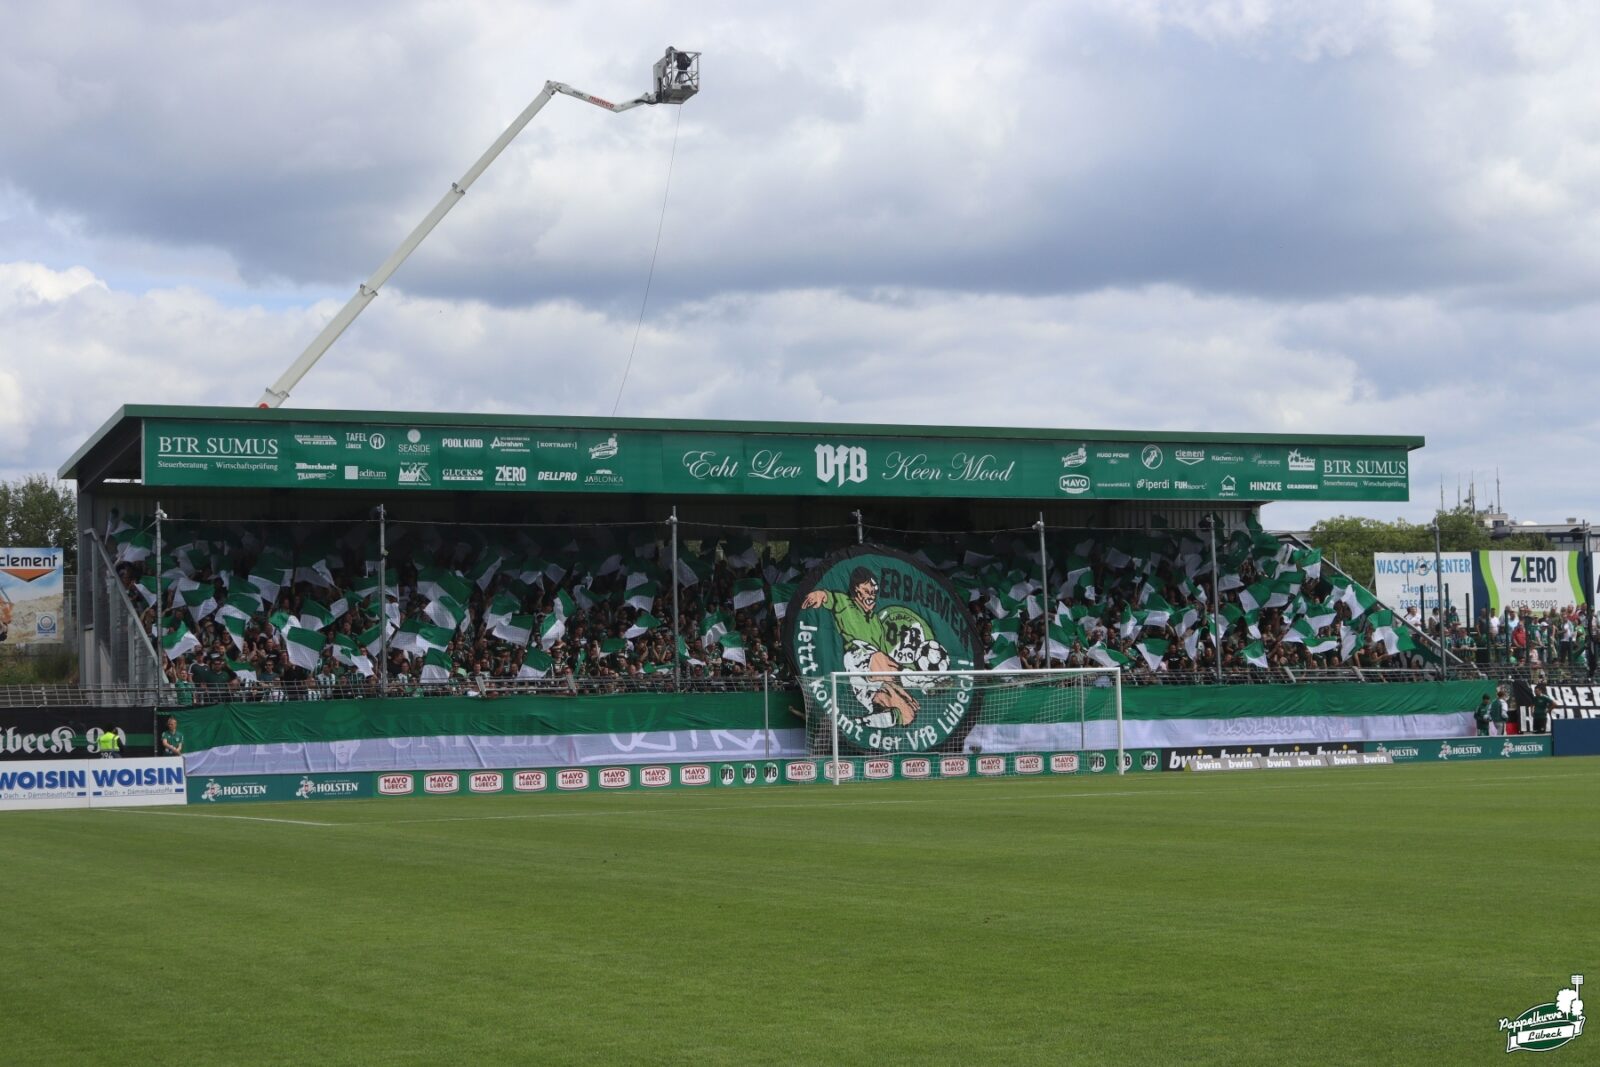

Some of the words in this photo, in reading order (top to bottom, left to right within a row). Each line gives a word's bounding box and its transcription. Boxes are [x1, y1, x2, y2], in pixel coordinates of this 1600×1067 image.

[345, 433, 367, 442] TAFEL
[159, 437, 200, 453] BTR
[206, 438, 278, 454] SUMUS
[398, 444, 430, 452] SEASIDE
[490, 436, 524, 450] Abraham
[158, 461, 208, 470] Steuerberatung
[216, 462, 278, 471] Wirtschaftsprüfung
[682, 450, 739, 478] Echt
[747, 450, 802, 480] Leev
[882, 451, 942, 481] Keen
[948, 452, 1016, 482] Mood
[1324, 460, 1352, 474] BTR
[1356, 460, 1406, 474] SUMUS
[359, 470, 386, 478] aditum
[538, 471, 578, 481] DELLPRO
[1062, 479, 1086, 487] MAYO
[1146, 480, 1170, 491] iperdi
[1250, 482, 1282, 491] HINZKE
[1377, 560, 1414, 574] WASCH
[1402, 584, 1438, 595] Zieglstr.
[894, 650, 914, 662] 1919
[798, 621, 818, 674] Jetzt
[869, 730, 902, 751] der
[906, 725, 938, 751] VfB
[1228, 760, 1253, 768] bwin
[1267, 759, 1291, 767] bwin
[1298, 758, 1321, 766] bwin
[1334, 756, 1357, 764] bwin
[1363, 755, 1386, 763] bwin
[1196, 761, 1221, 769] bwin
[0, 770, 86, 790] WOISIN
[92, 767, 183, 788] WOISIN
[224, 785, 266, 795] HOLSTEN
[317, 783, 358, 792] HOLSTEN
